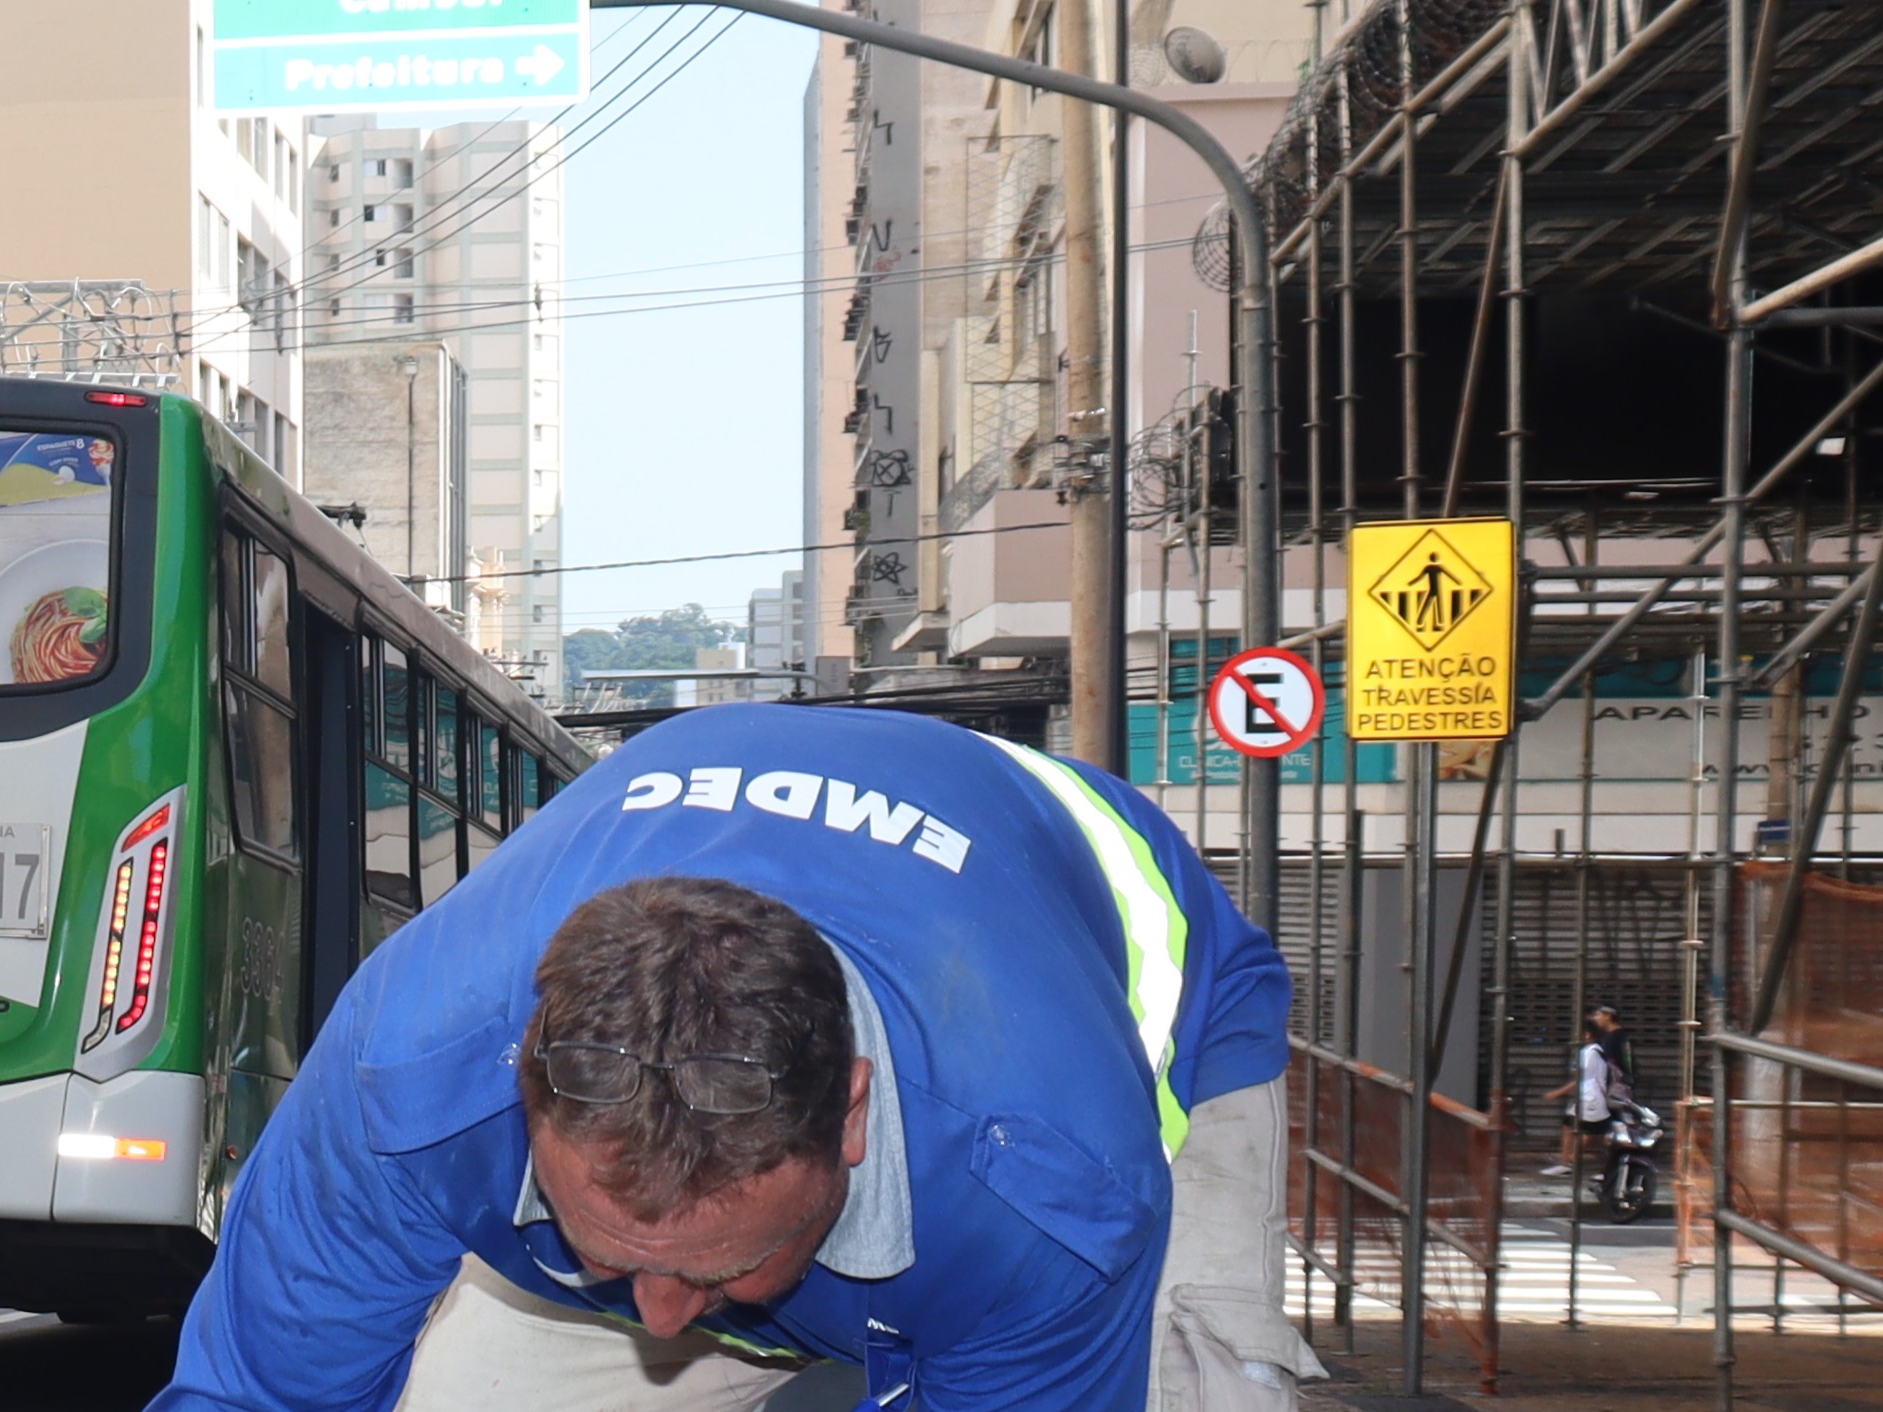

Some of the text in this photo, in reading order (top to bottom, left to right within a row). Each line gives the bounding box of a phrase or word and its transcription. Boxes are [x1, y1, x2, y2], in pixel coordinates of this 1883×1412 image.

[284, 55, 505, 91] Prefeitura
[1365, 653, 1497, 684] ATENÇÃO
[1245, 673, 1285, 734] E
[1358, 710, 1502, 732] PEDESTRES
[622, 767, 971, 874] EMDEC
